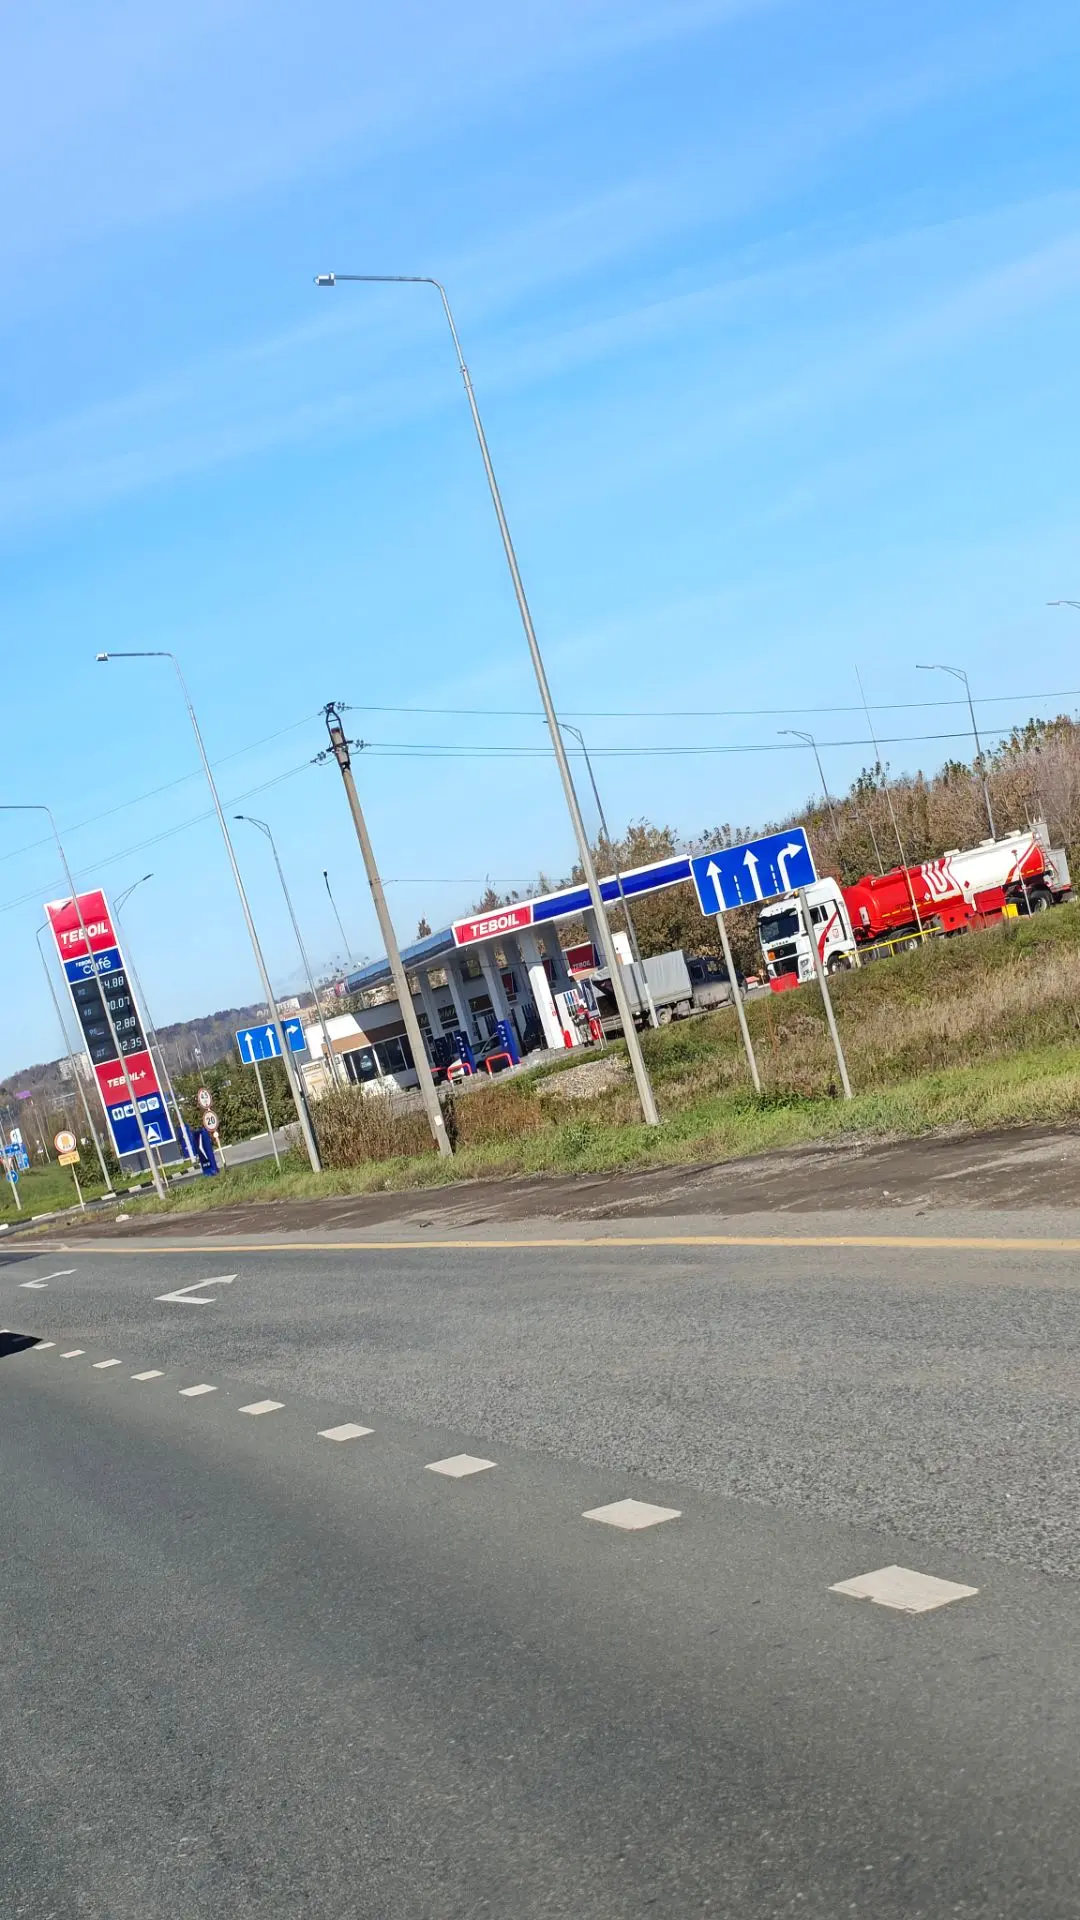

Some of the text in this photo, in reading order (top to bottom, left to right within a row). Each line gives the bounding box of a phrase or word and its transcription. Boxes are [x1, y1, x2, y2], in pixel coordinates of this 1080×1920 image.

[470, 913, 520, 937] TEBOIL
[60, 922, 109, 944] TEBOIL
[107, 996, 130, 1010] 0.07
[113, 1016, 136, 1031] 2.88
[120, 1037, 142, 1051] 2.35
[206, 1116, 215, 1125] 20
